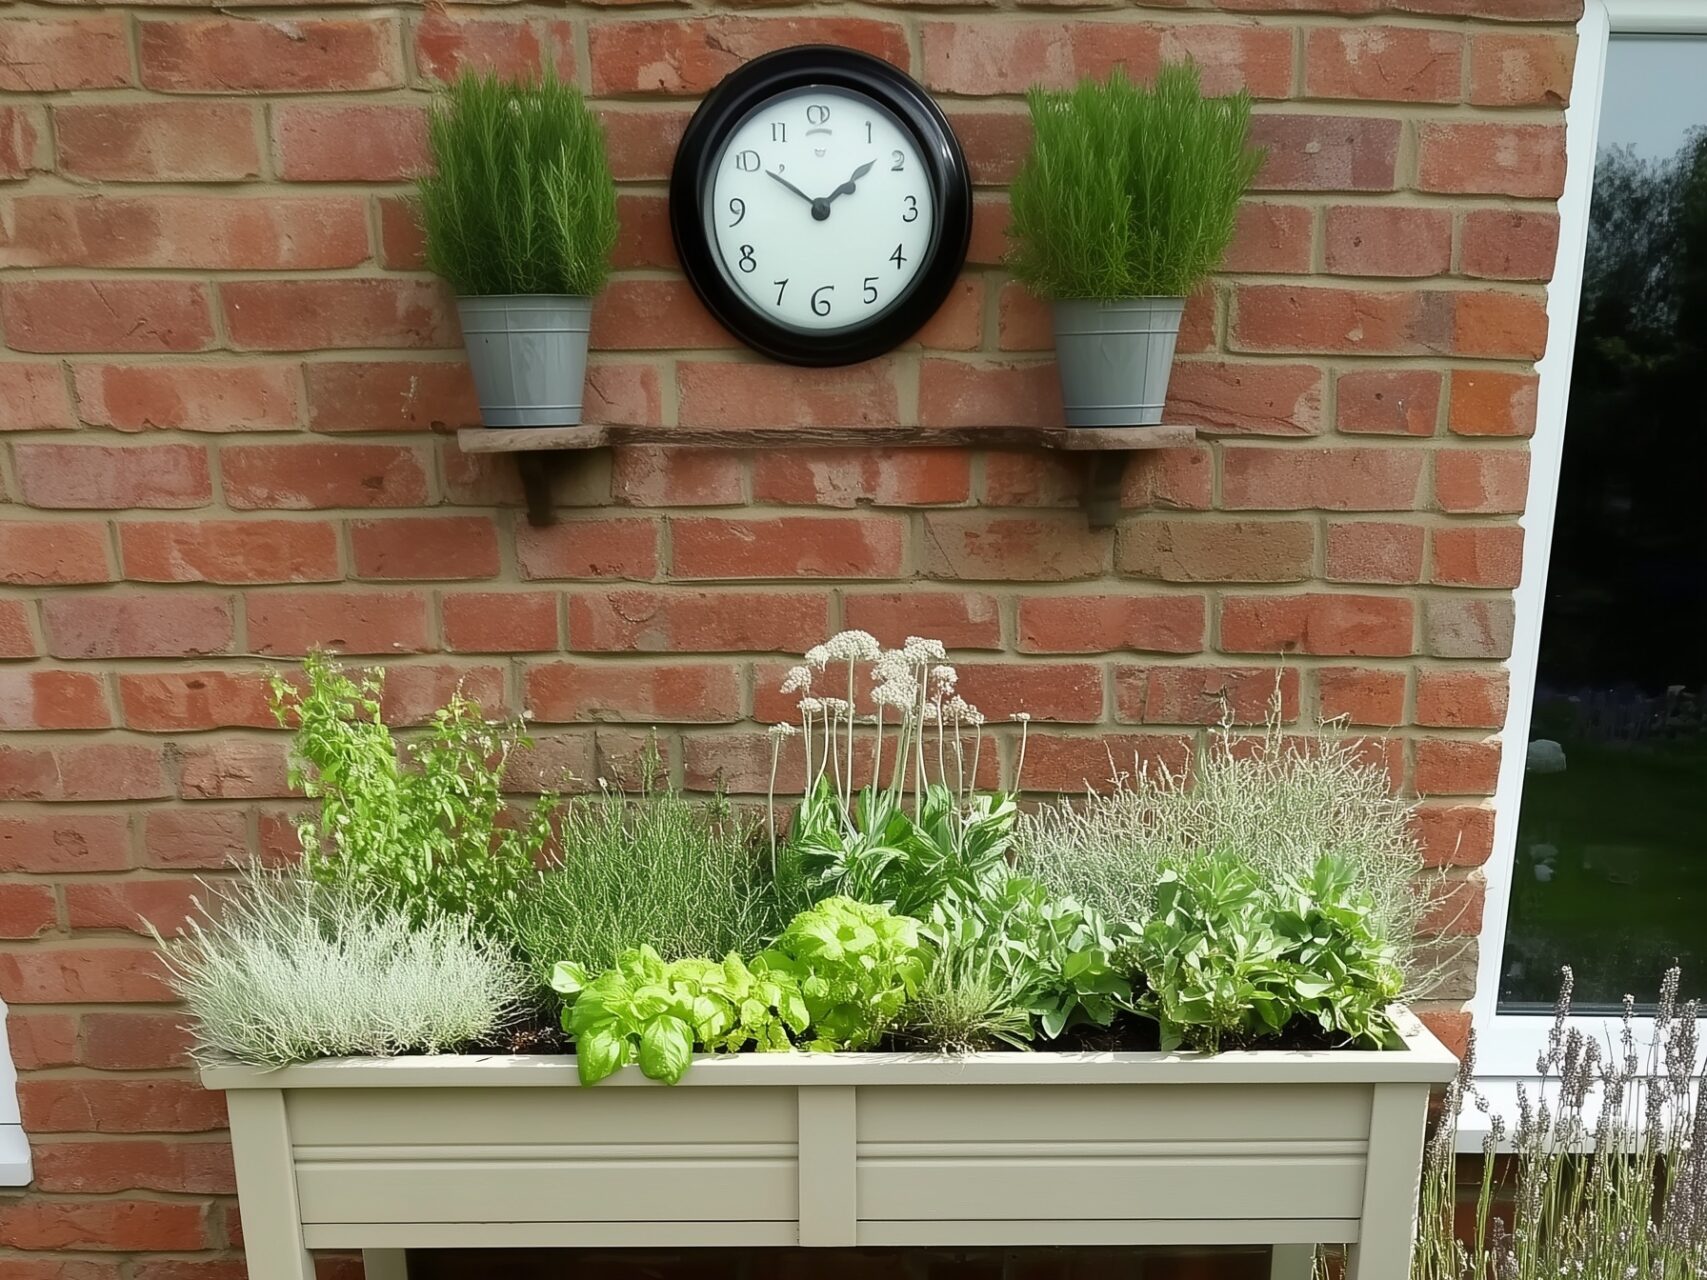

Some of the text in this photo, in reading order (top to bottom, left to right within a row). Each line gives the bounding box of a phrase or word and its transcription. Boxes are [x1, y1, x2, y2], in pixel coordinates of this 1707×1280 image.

[864, 120, 873, 145] 1
[890, 149, 906, 173] 2
[728, 197, 746, 228] 9
[902, 195, 919, 223] 3
[738, 244, 757, 274] 8
[888, 243, 908, 270] 4
[773, 278, 789, 307] 7
[810, 285, 835, 317] 6
[863, 276, 879, 305] 5
